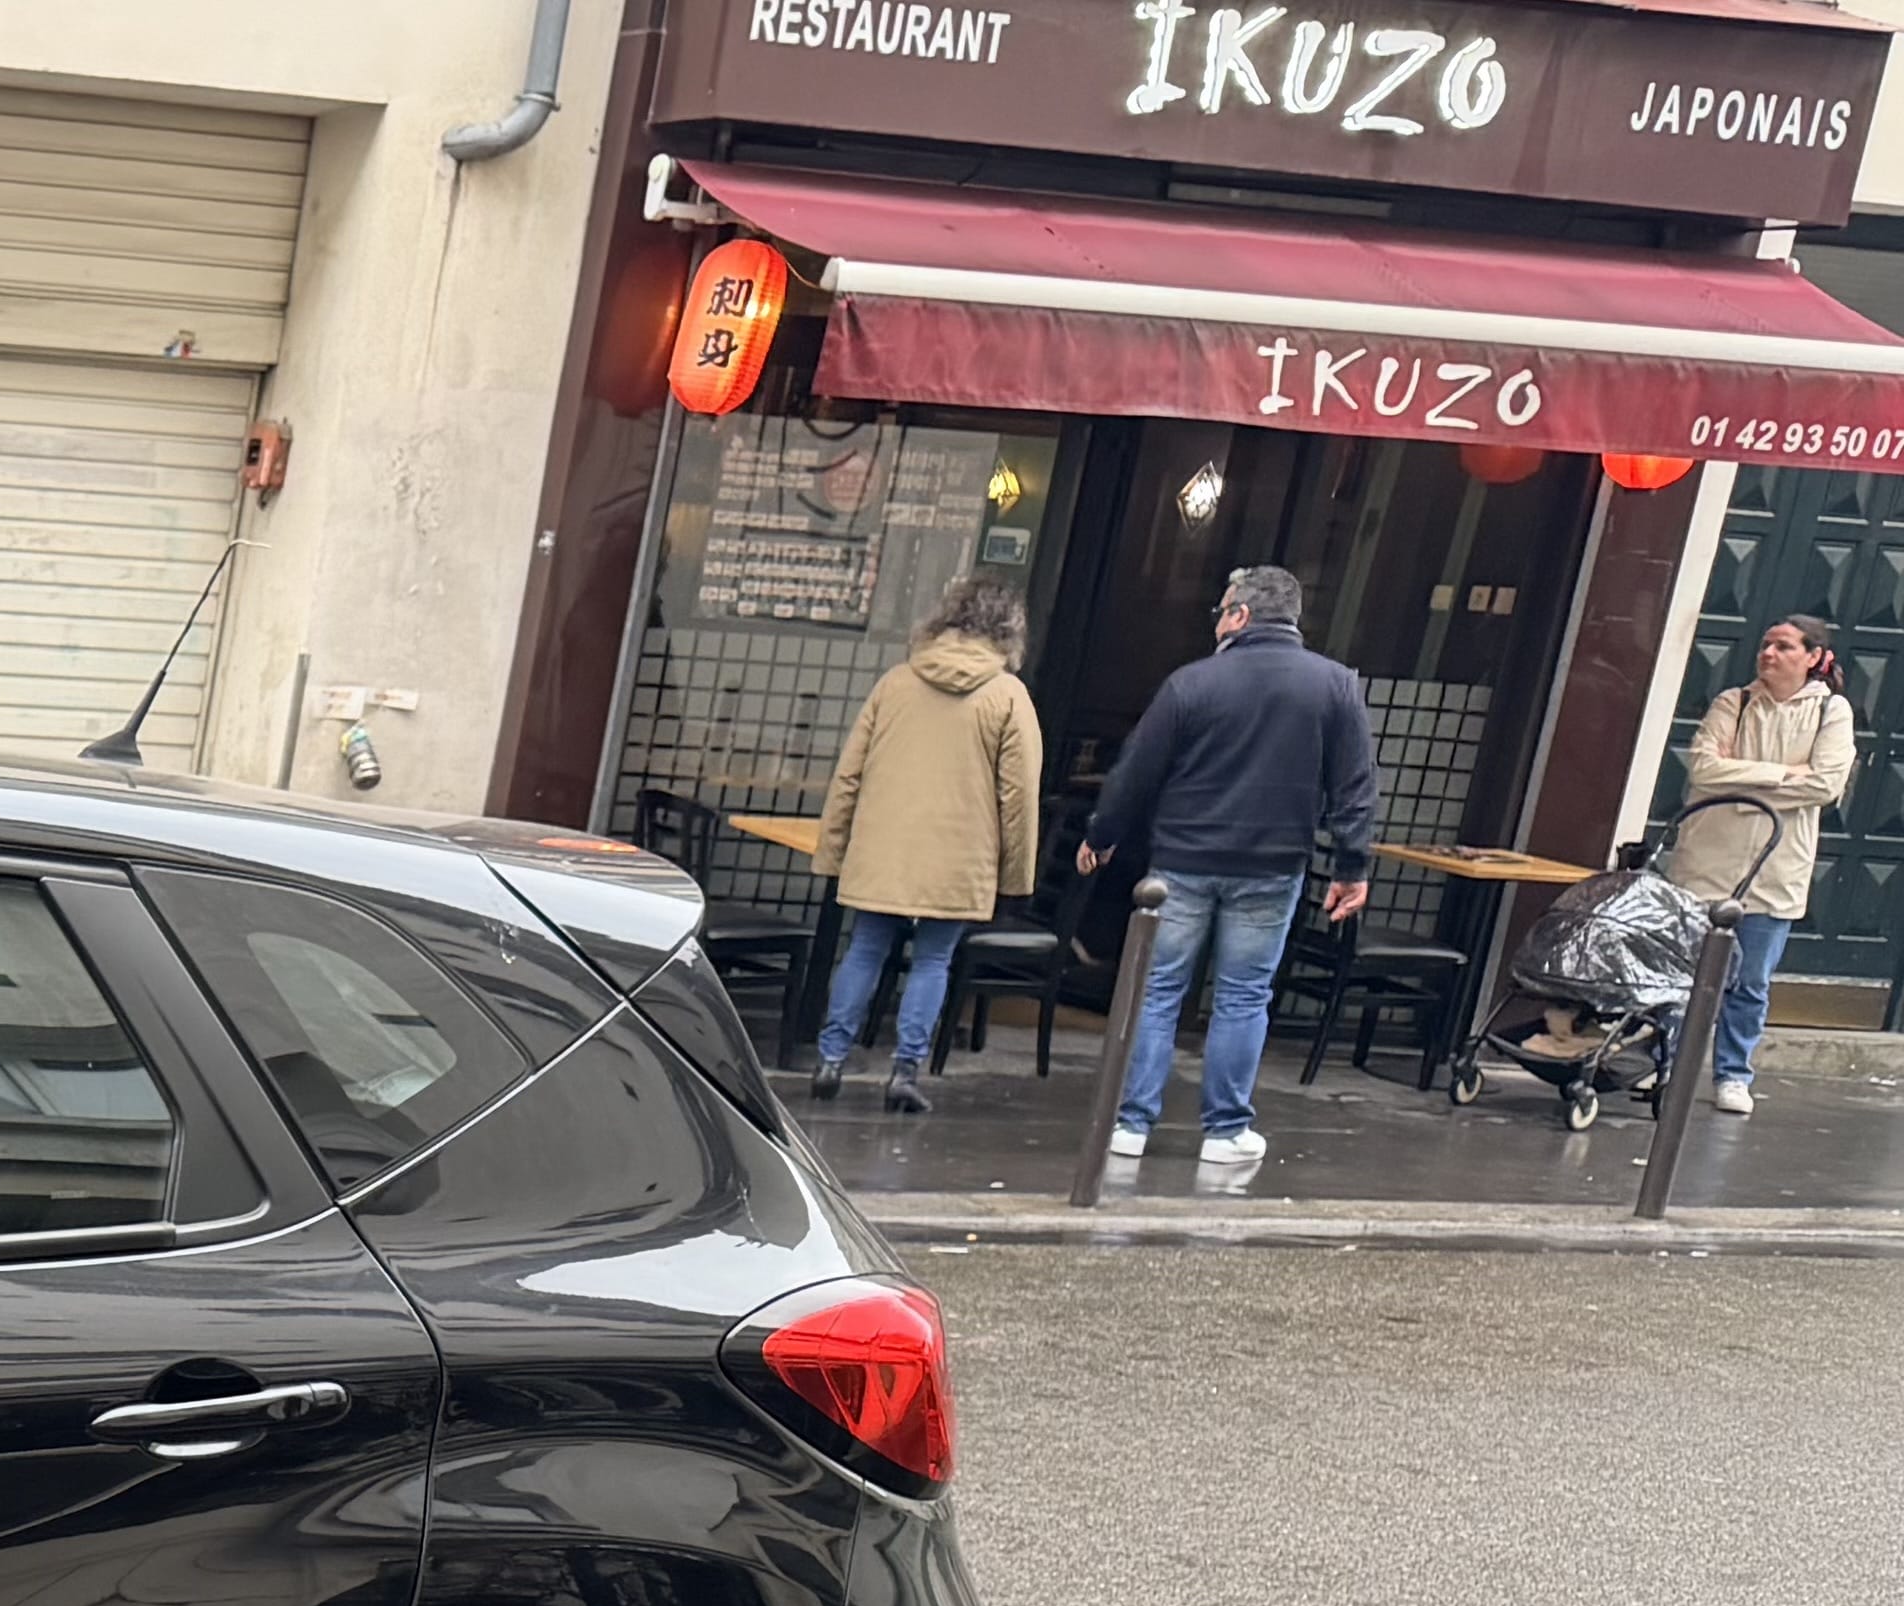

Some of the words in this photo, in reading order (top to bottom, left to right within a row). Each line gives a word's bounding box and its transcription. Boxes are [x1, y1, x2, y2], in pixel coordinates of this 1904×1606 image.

[749, 0, 1010, 64] RESTAURANT
[1127, 0, 1507, 136] IKUZO
[1630, 82, 1852, 150] JAPONAIS
[696, 275, 755, 369] 刺身
[1257, 336, 1542, 430] IKUZO
[1691, 415, 1730, 447] 01
[1735, 419, 1778, 451] 42
[1782, 423, 1824, 454] 93
[1829, 426, 1868, 457] 50
[1872, 428, 1904, 460] 07
